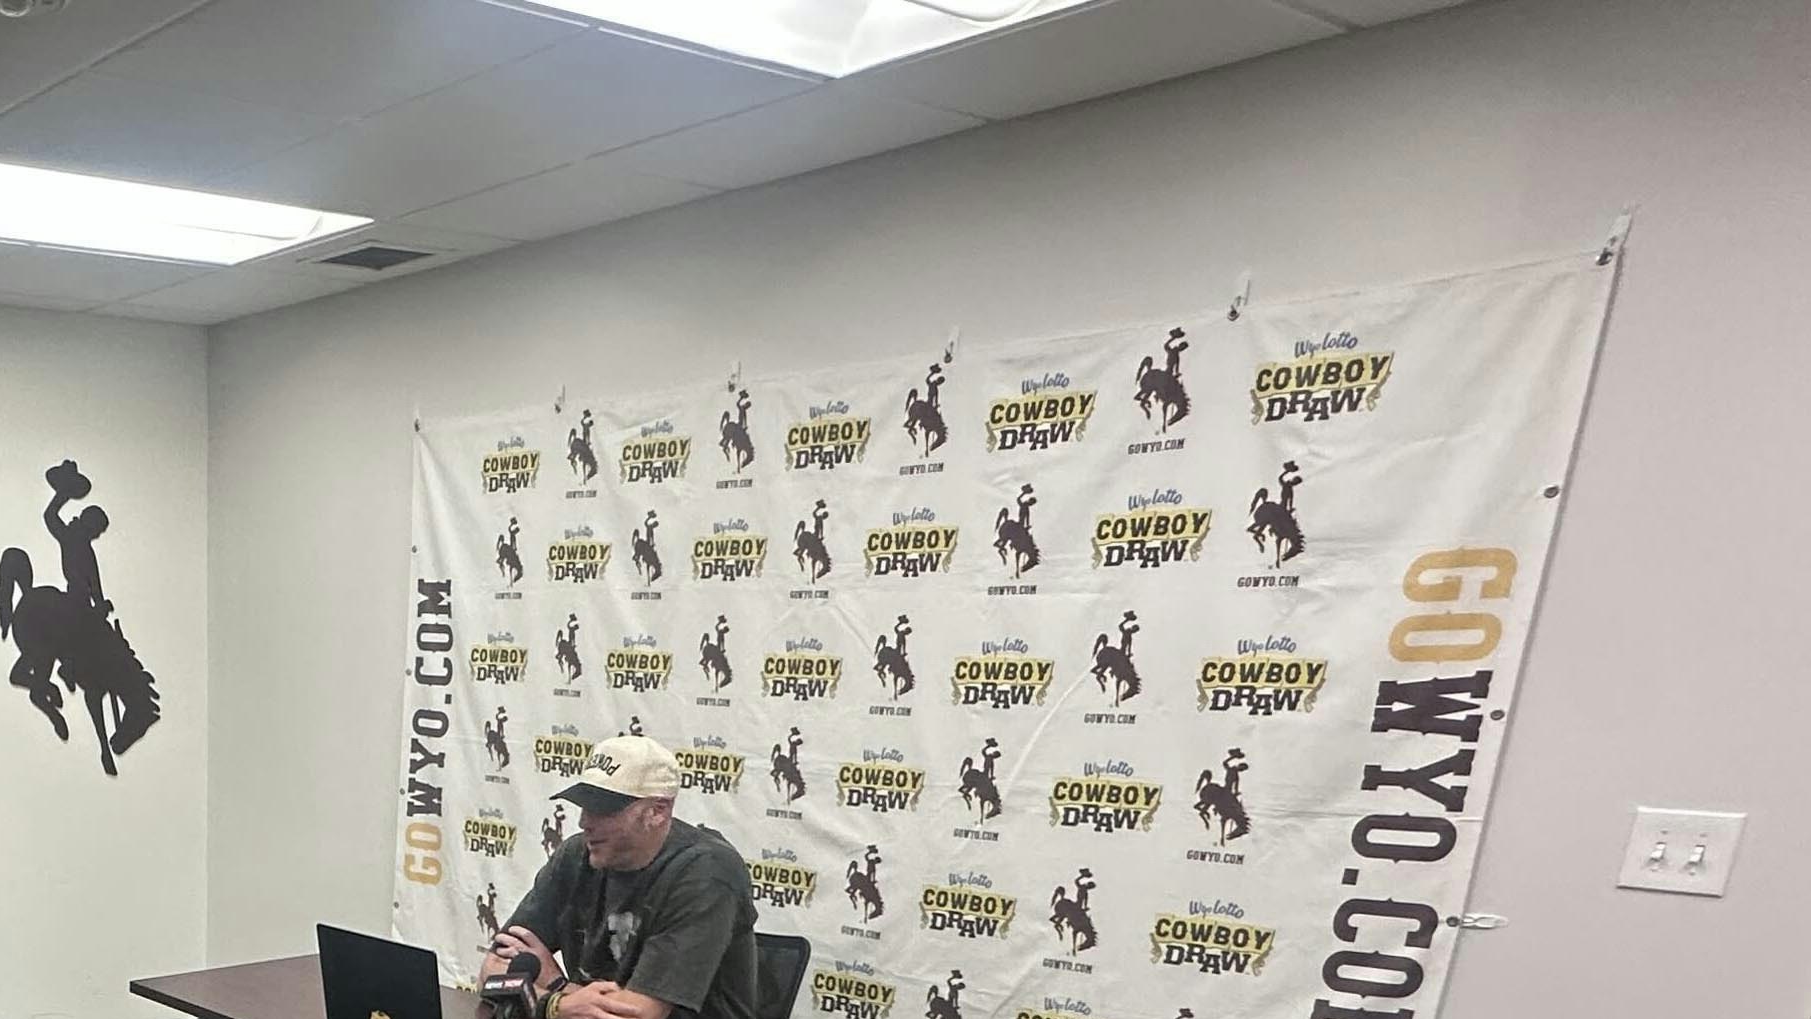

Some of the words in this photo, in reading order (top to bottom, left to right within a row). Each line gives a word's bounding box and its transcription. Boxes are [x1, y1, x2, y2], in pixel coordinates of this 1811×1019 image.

[1256, 356, 1389, 393] COWBOY
[990, 394, 1093, 424] COWBOY
[1264, 387, 1366, 422] DRAW
[788, 421, 868, 445] COWBOY
[999, 422, 1076, 451] DRAW
[622, 439, 689, 460] COWBOY
[795, 445, 855, 469] DRAW
[1128, 439, 1185, 455] GOWYO.COM
[483, 453, 538, 473] COWBOY
[628, 460, 679, 484] DRAW
[900, 463, 944, 475] GOWYO.COM
[488, 473, 530, 493] DRAW
[1096, 512, 1208, 540] COWBOY
[694, 539, 765, 557] COWBOY
[867, 529, 955, 551] COWBOY
[549, 544, 610, 562] COWBOY
[1103, 540, 1187, 568] DRAW
[555, 562, 598, 582] DRAW
[701, 559, 754, 581] DRAW
[875, 552, 942, 577] DRAW
[988, 584, 1036, 595] GOWYO.COM
[1238, 575, 1298, 588] GOWYO.COM
[790, 589, 828, 599] GOWYO.COM
[471, 648, 527, 663] COWBOY
[607, 653, 671, 669] COWBOY
[765, 658, 840, 675] COWBOY
[476, 665, 520, 684] DRAW
[613, 671, 661, 692] DRAW
[955, 661, 1051, 680] COWBOY
[1201, 662, 1323, 683] COWBOY
[771, 677, 828, 700] DRAW
[963, 682, 1034, 708] DRAW
[869, 706, 911, 716] GOWYO.COM
[1211, 685, 1303, 715] DRAW
[1084, 714, 1135, 725] GOWYO.COM
[403, 579, 453, 886] GOWYO.COM
[535, 739, 591, 757] COWBOY
[541, 757, 583, 777] DRAW
[839, 766, 921, 788] COWBOY
[680, 771, 732, 794] DRAW
[1053, 782, 1159, 805] COWBOY
[847, 787, 909, 812] DRAW
[1061, 804, 1140, 832] DRAW
[464, 821, 516, 840] COWBOY
[953, 829, 998, 840] GOWYO.COM
[470, 837, 507, 857] DRAW
[1187, 850, 1244, 864] GOWYO.COM
[747, 864, 815, 887] OWBOY
[751, 885, 803, 907] DRAW
[923, 889, 1013, 915] COWBOY
[930, 912, 998, 938] DRAW
[1155, 919, 1271, 949] COWBOY
[1043, 958, 1092, 974] GOWYO.COM
[1164, 943, 1251, 974] DRAW
[814, 974, 892, 1003] COWBOY
